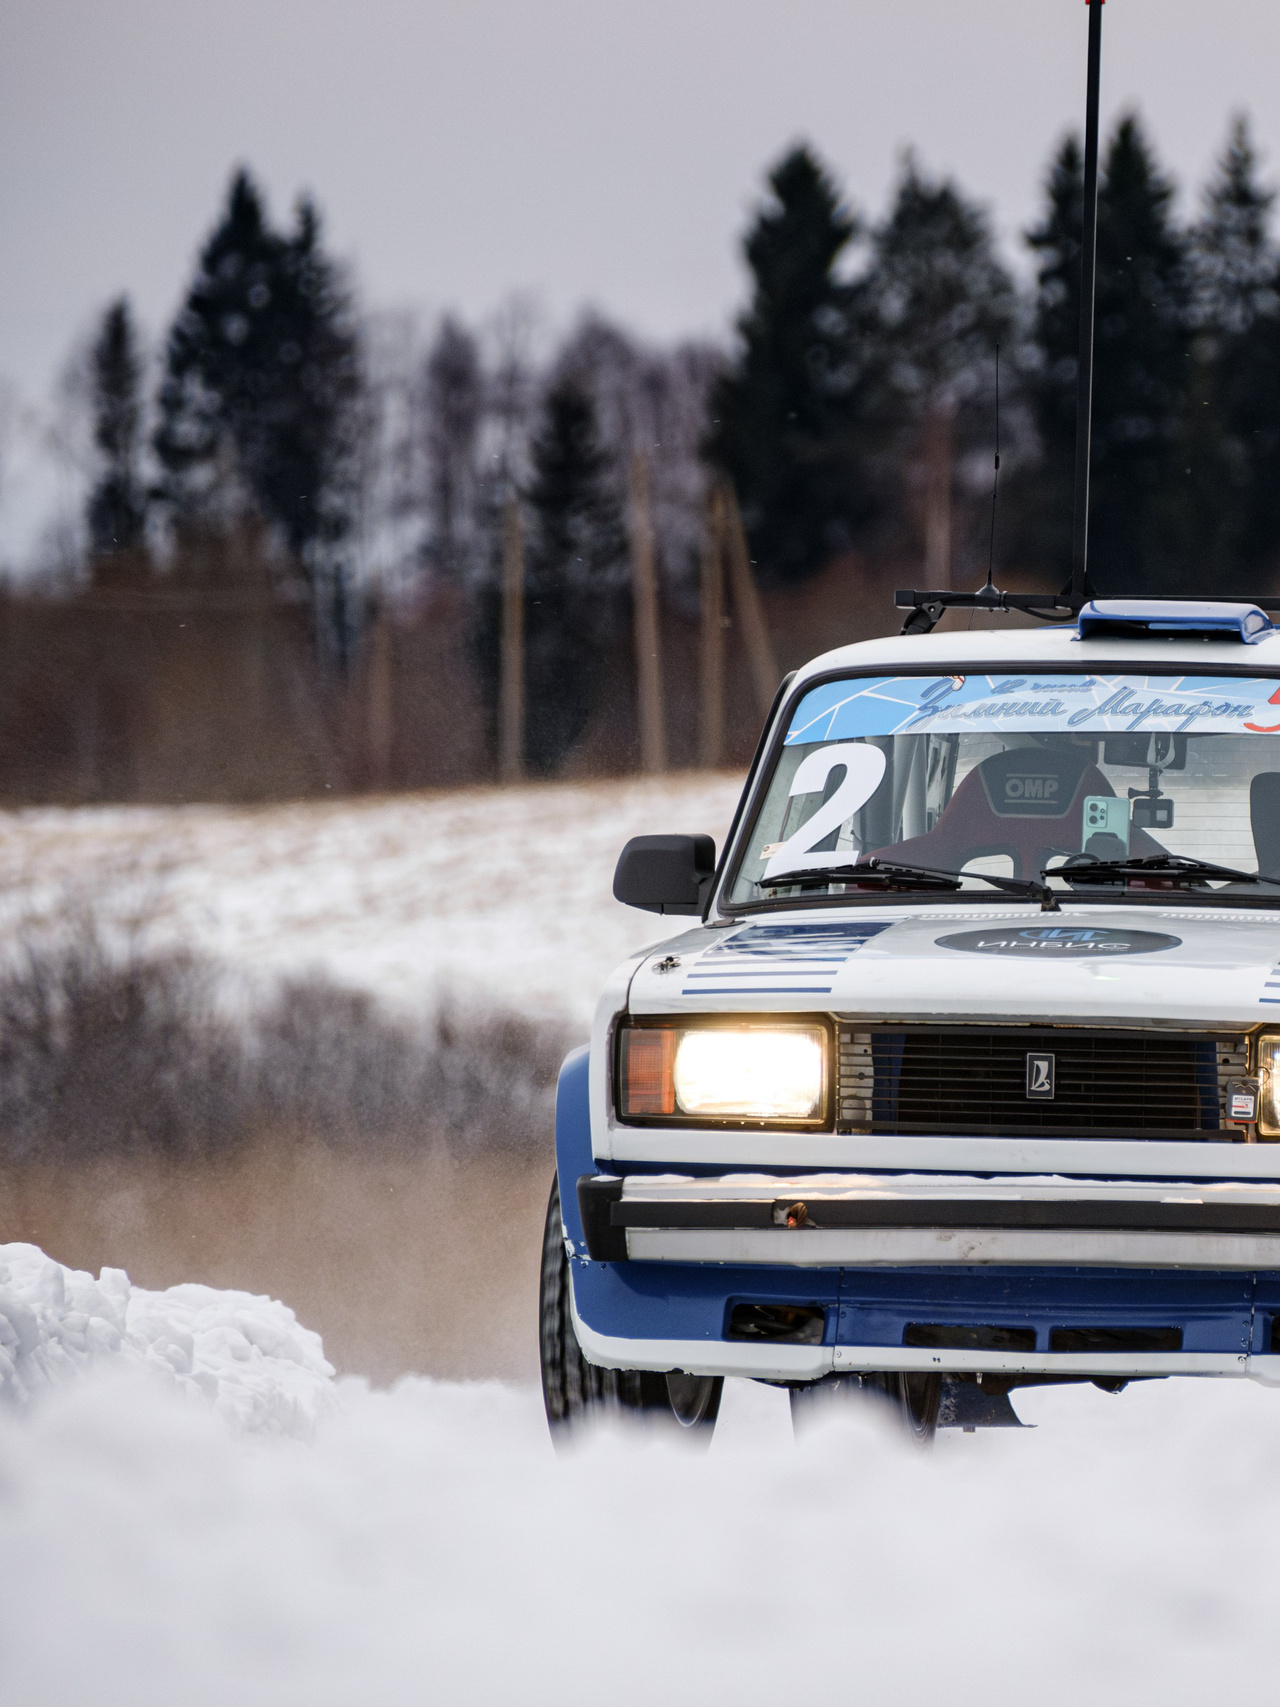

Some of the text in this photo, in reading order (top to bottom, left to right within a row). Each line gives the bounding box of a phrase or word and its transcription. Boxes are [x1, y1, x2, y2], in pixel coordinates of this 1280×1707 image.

[906, 678, 1067, 732] Зимний
[1067, 686, 1255, 733] Марафон
[1005, 778, 1059, 798] OMP
[762, 743, 887, 881] 2
[977, 940, 1132, 949] ИНБИС
